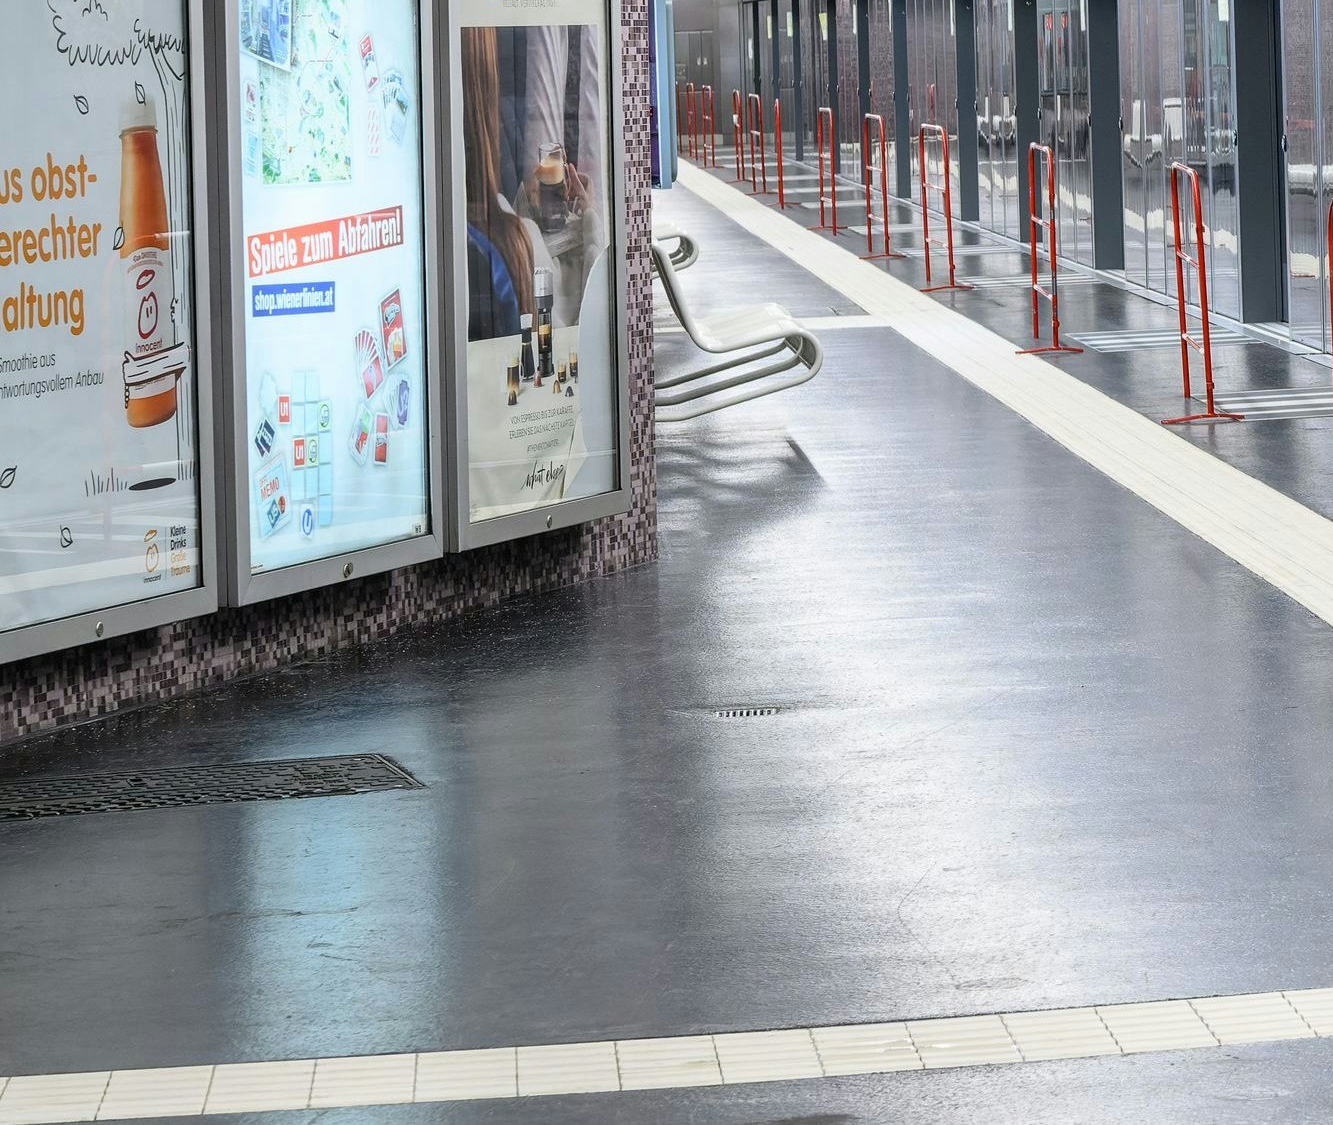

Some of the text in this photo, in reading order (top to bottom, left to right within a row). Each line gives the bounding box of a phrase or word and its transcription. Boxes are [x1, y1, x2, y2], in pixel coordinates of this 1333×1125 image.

[31, 152, 97, 201] obst-
[251, 208, 402, 275] Spiele zum Abfahren!
[2, 281, 85, 336] altung
[254, 286, 334, 315] shop.wienerlinien.at
[136, 339, 163, 354] innocent
[40, 353, 56, 368] aus
[75, 369, 104, 388] Anbau
[170, 538, 187, 550] Drinks
